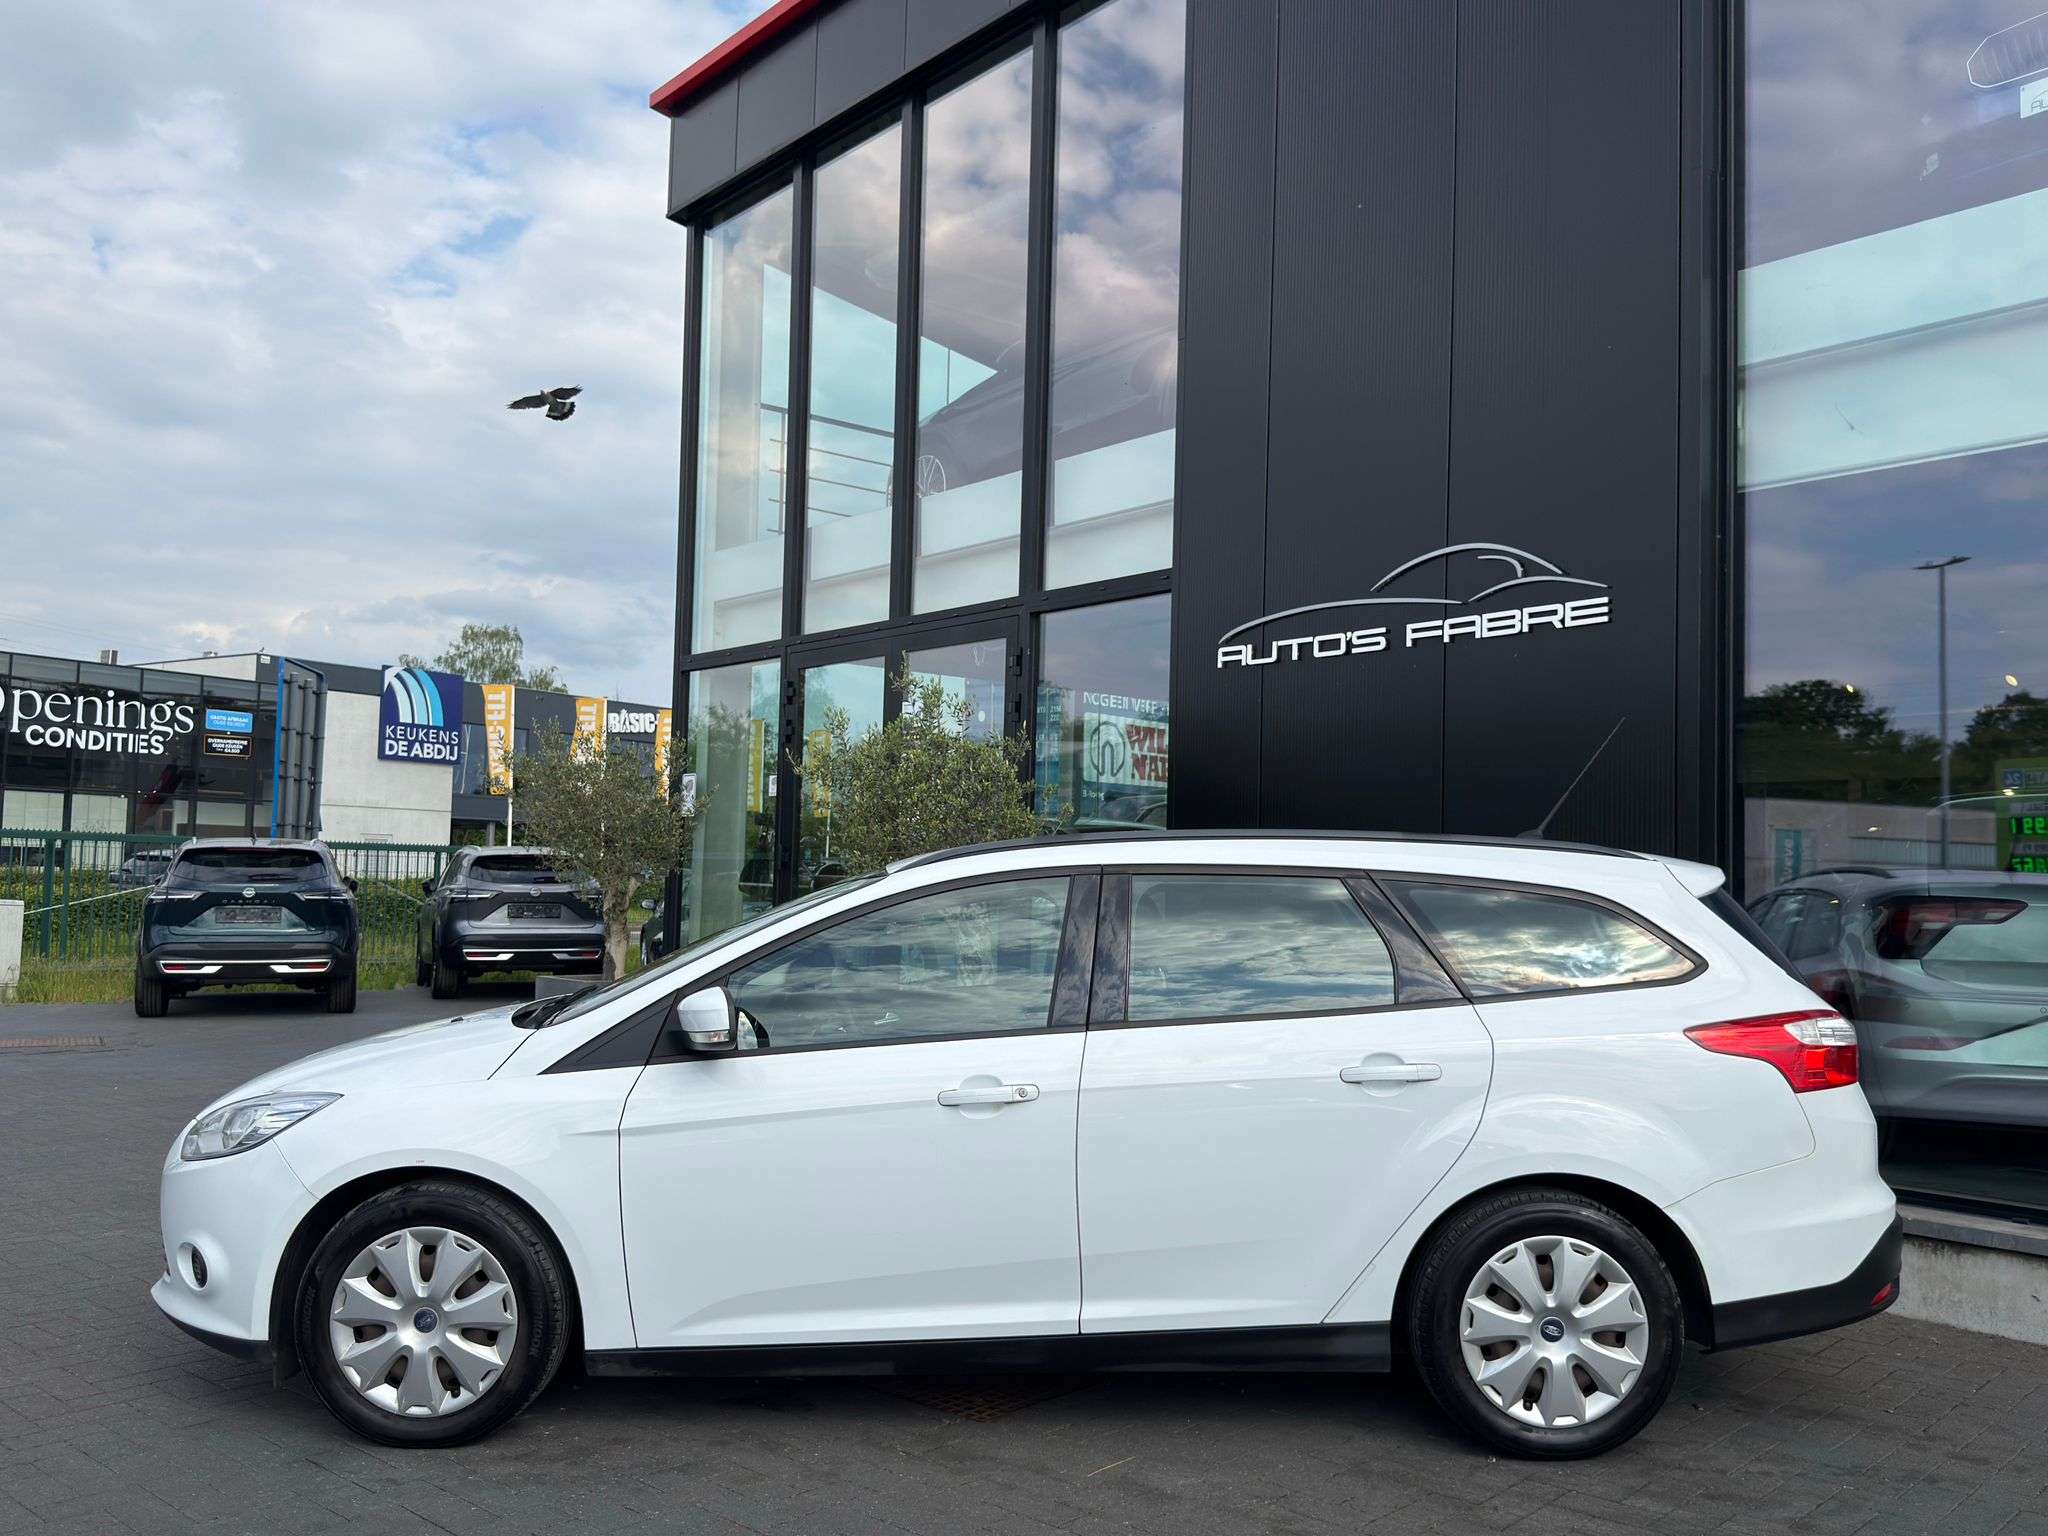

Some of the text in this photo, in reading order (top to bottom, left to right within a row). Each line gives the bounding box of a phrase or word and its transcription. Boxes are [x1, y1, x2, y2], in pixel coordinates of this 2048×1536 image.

[1216, 596, 1610, 669] AUTO'S FABRE
[25, 724, 166, 755] CONDITIES
[385, 725, 459, 744] KEUKENS
[385, 740, 459, 761] DE ABDIJ
